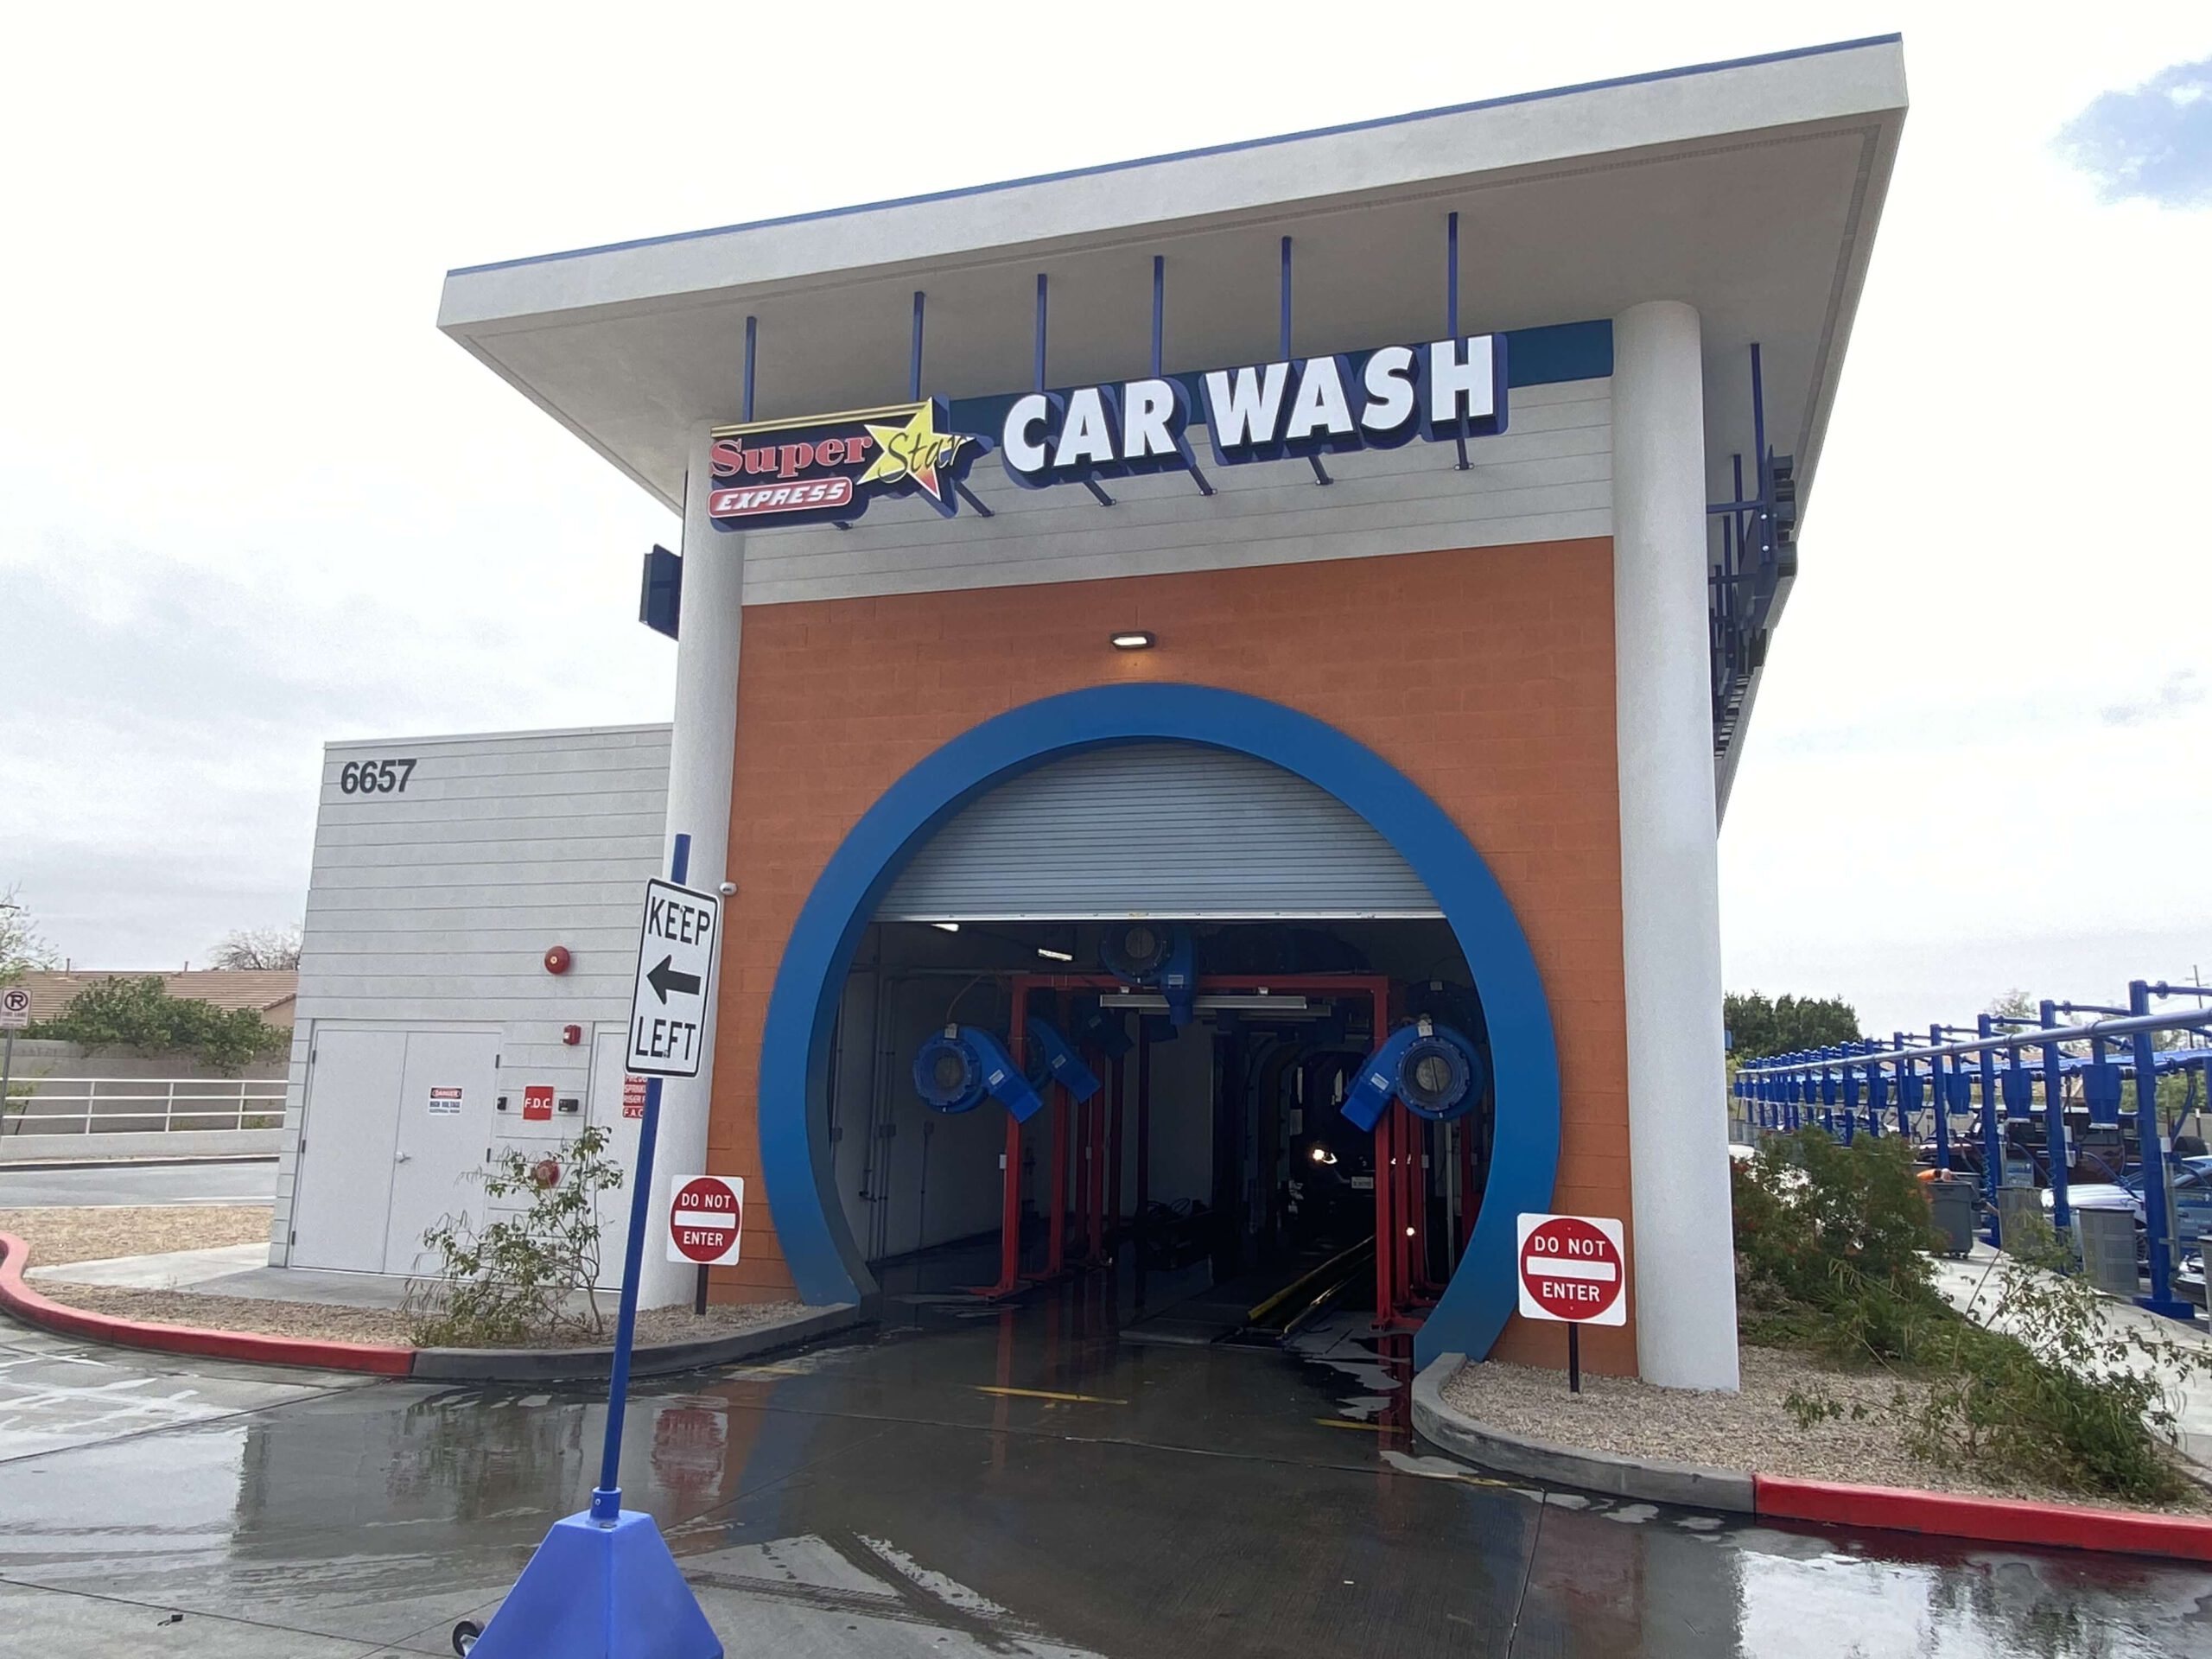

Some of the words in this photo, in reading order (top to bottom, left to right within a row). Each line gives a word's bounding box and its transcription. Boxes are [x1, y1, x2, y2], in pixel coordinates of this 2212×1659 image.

[1002, 378, 1178, 473] CAR
[1205, 334, 1495, 447] WASH
[709, 435, 874, 478] Super
[878, 431, 968, 484] Star
[715, 482, 848, 512] EXPRESS
[341, 759, 416, 794] 6657
[648, 896, 710, 945] KEEP
[635, 1015, 696, 1060] LEFT
[681, 1193, 699, 1206] DO
[705, 1194, 731, 1208] NOT
[683, 1231, 723, 1246] ENTER
[1535, 1236, 1559, 1253] DO
[1568, 1238, 1605, 1256] NOT
[1542, 1281, 1600, 1302] ENTER
